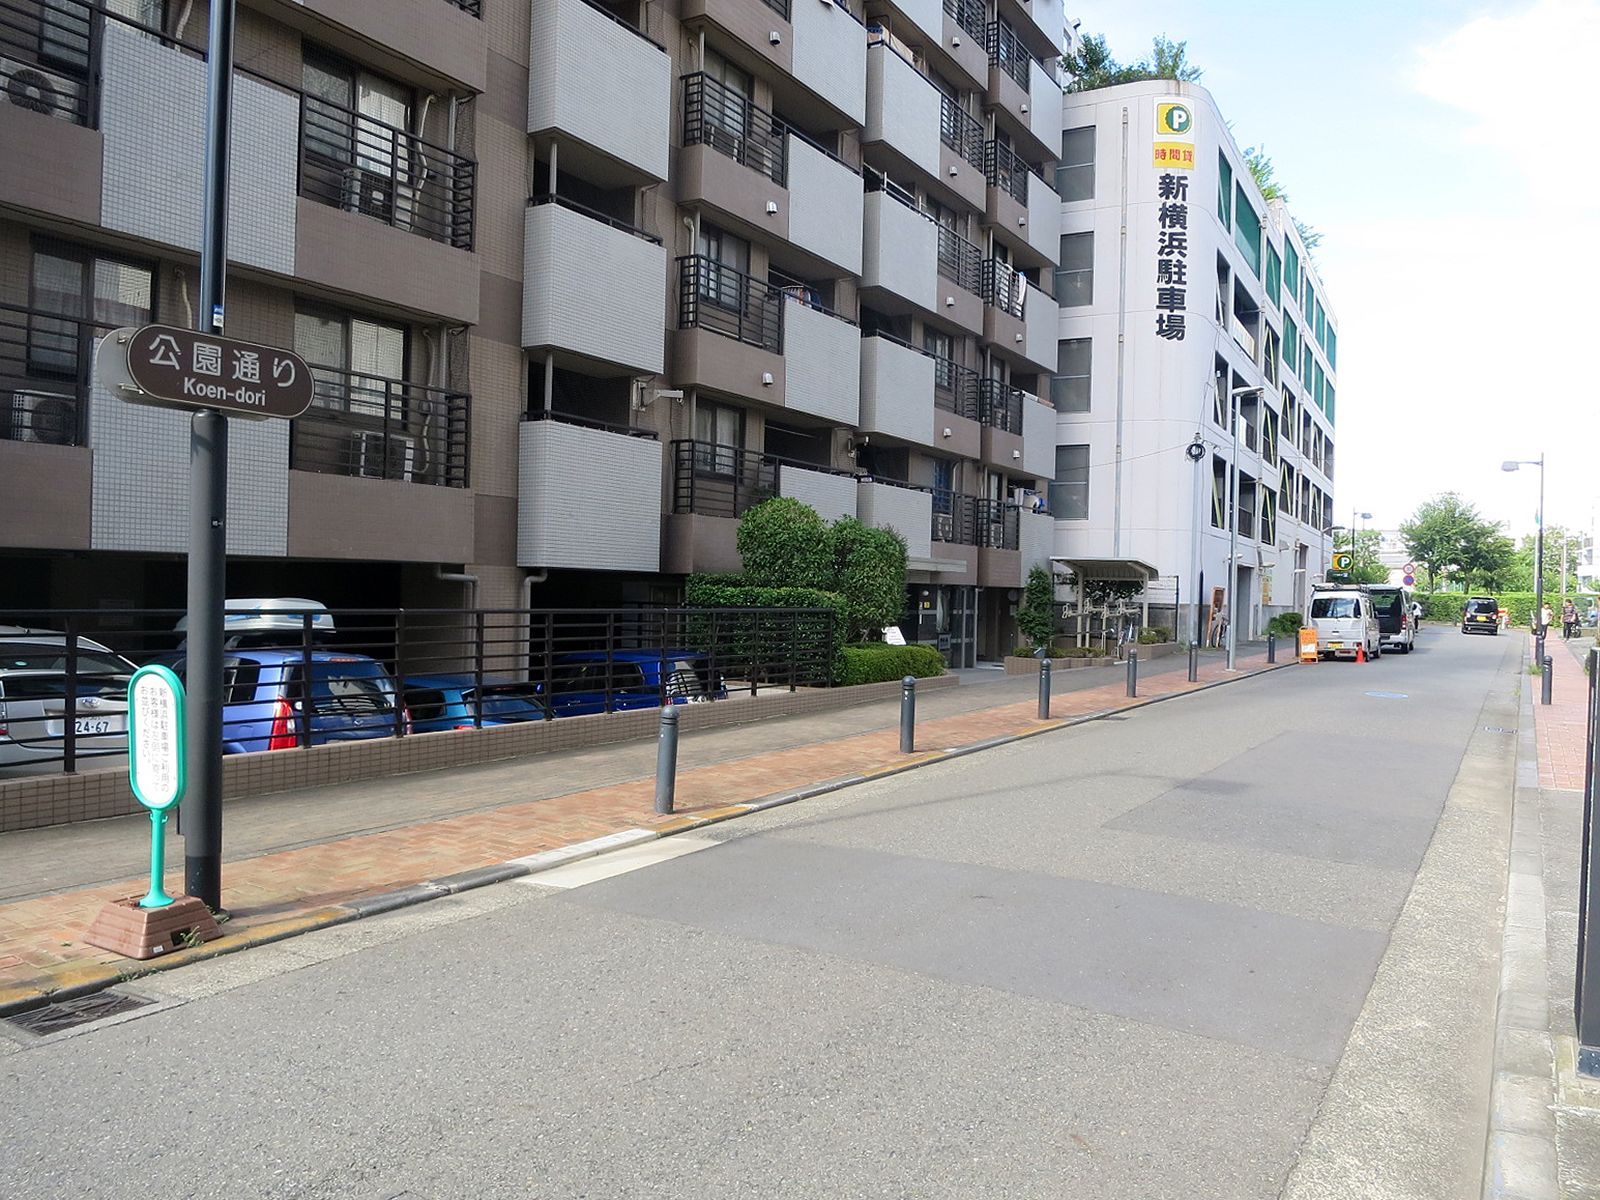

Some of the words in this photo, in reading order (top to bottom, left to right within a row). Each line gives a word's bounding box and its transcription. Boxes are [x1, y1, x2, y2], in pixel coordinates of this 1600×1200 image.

[1172, 109, 1187, 130] P
[1154, 148, 1193, 163] 時間貸
[1155, 173, 1189, 341] 新横浜駐車場
[149, 334, 296, 388] 公園通り
[183, 377, 267, 406] Koen-dori
[1340, 556, 1350, 568] P
